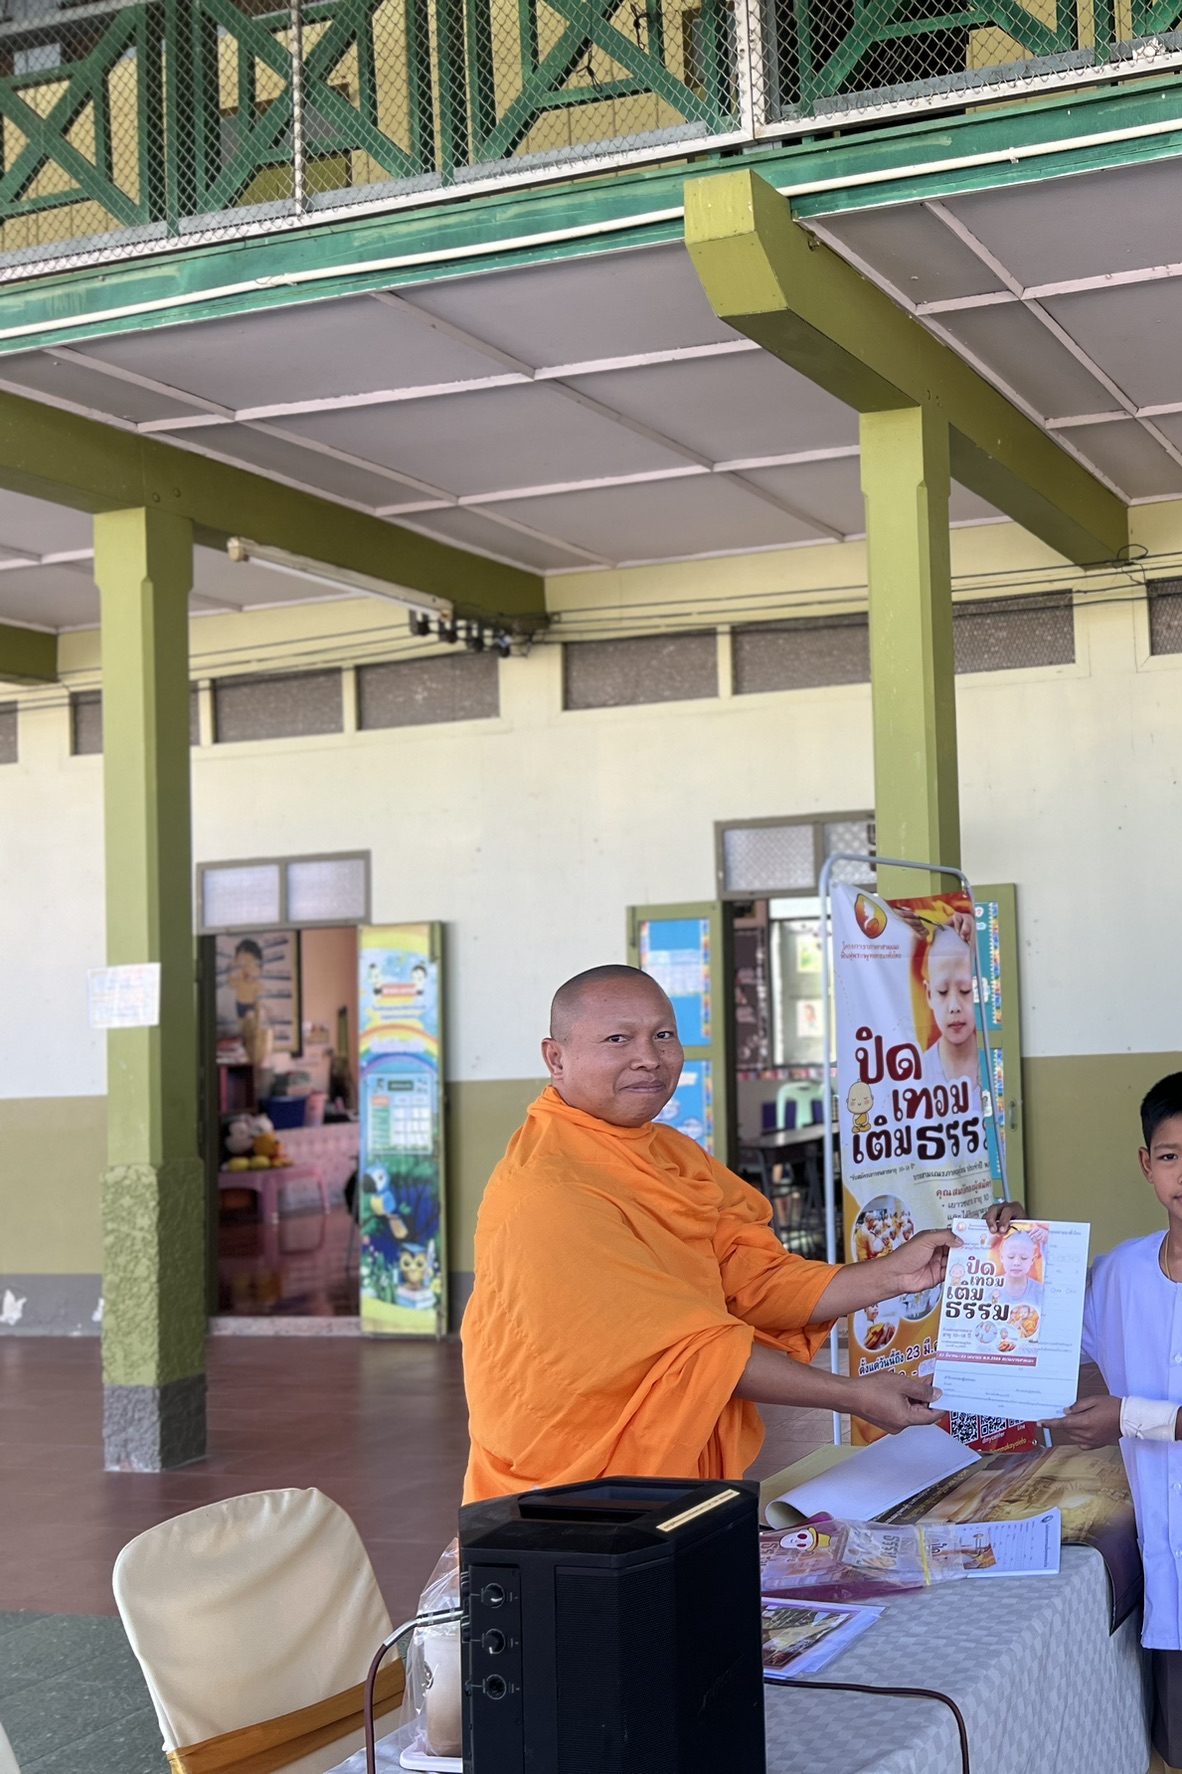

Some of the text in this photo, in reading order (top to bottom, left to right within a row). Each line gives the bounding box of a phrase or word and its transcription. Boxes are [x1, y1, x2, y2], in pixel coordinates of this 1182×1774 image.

[855, 1026, 922, 1084] ปิด
[892, 1081, 969, 1122] เทอม
[967, 1256, 995, 1275] ปิด
[947, 1280, 984, 1301] เติม
[970, 1275, 1004, 1287] เทอม
[945, 1301, 1010, 1321] ธรรม
[906, 1344, 920, 1361] 23
